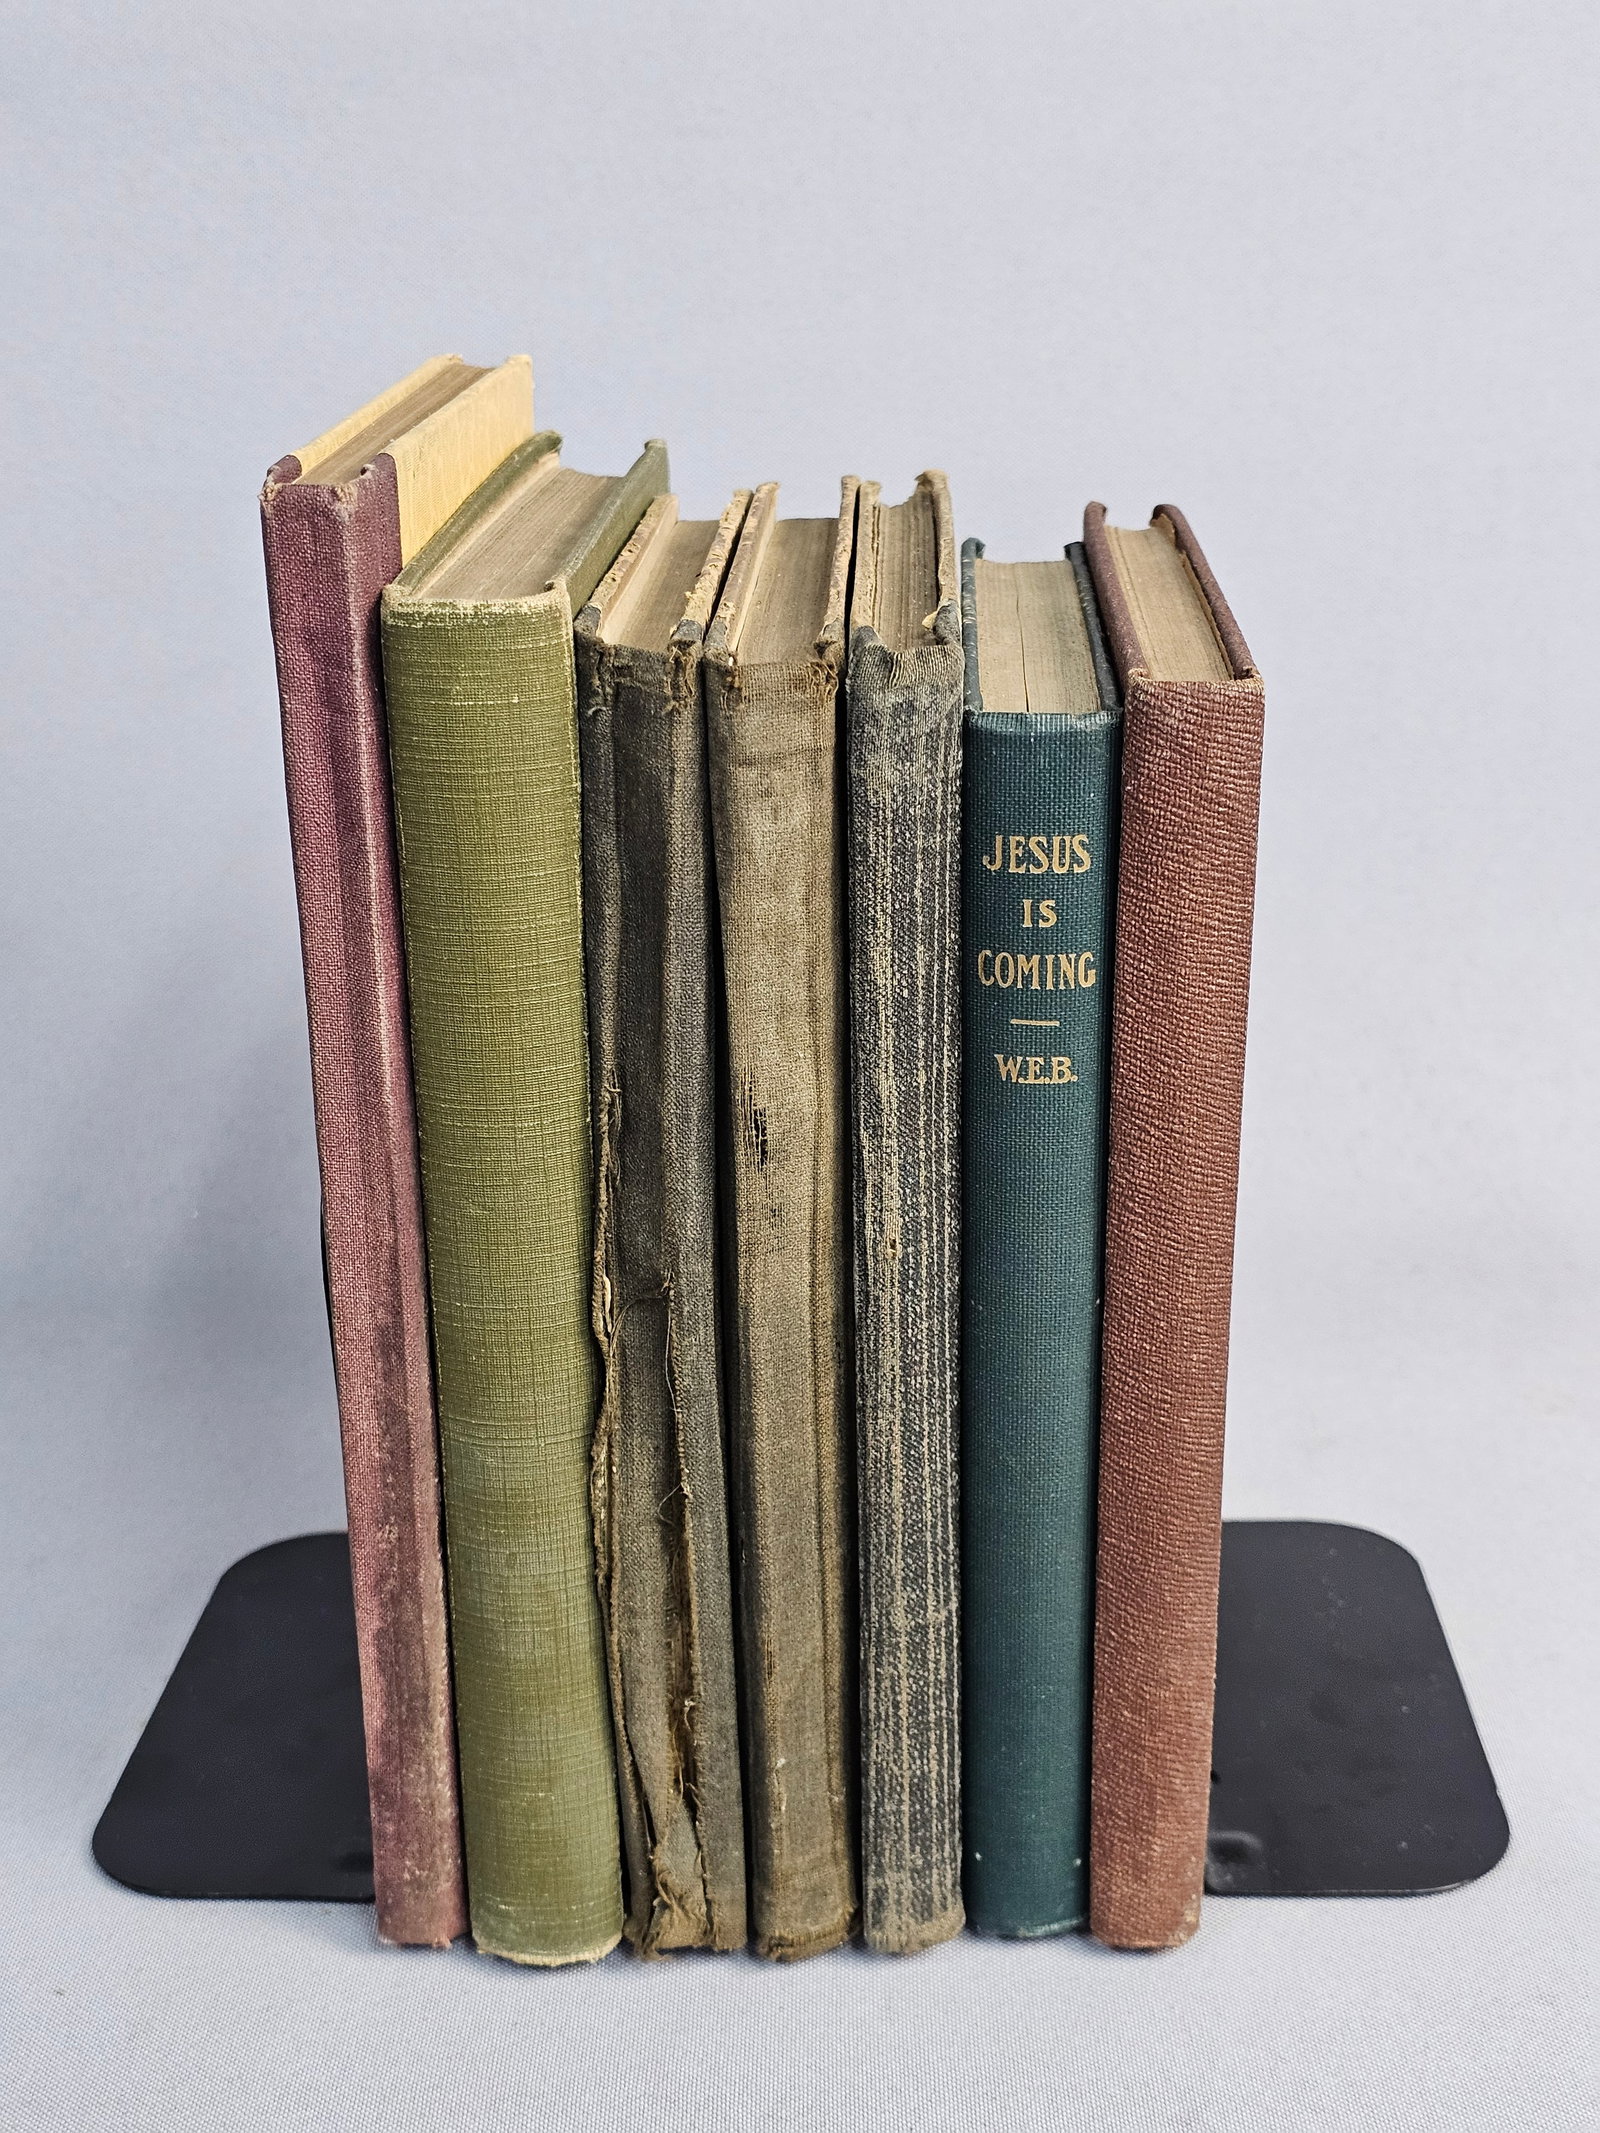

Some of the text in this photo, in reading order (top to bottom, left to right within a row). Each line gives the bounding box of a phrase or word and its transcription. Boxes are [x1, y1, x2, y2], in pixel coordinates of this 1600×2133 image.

[983, 834, 1092, 874] JESUS
[1022, 899, 1058, 928] IS
[977, 950, 1097, 990] COMING
[993, 1054, 1079, 1084] W.E.B.
